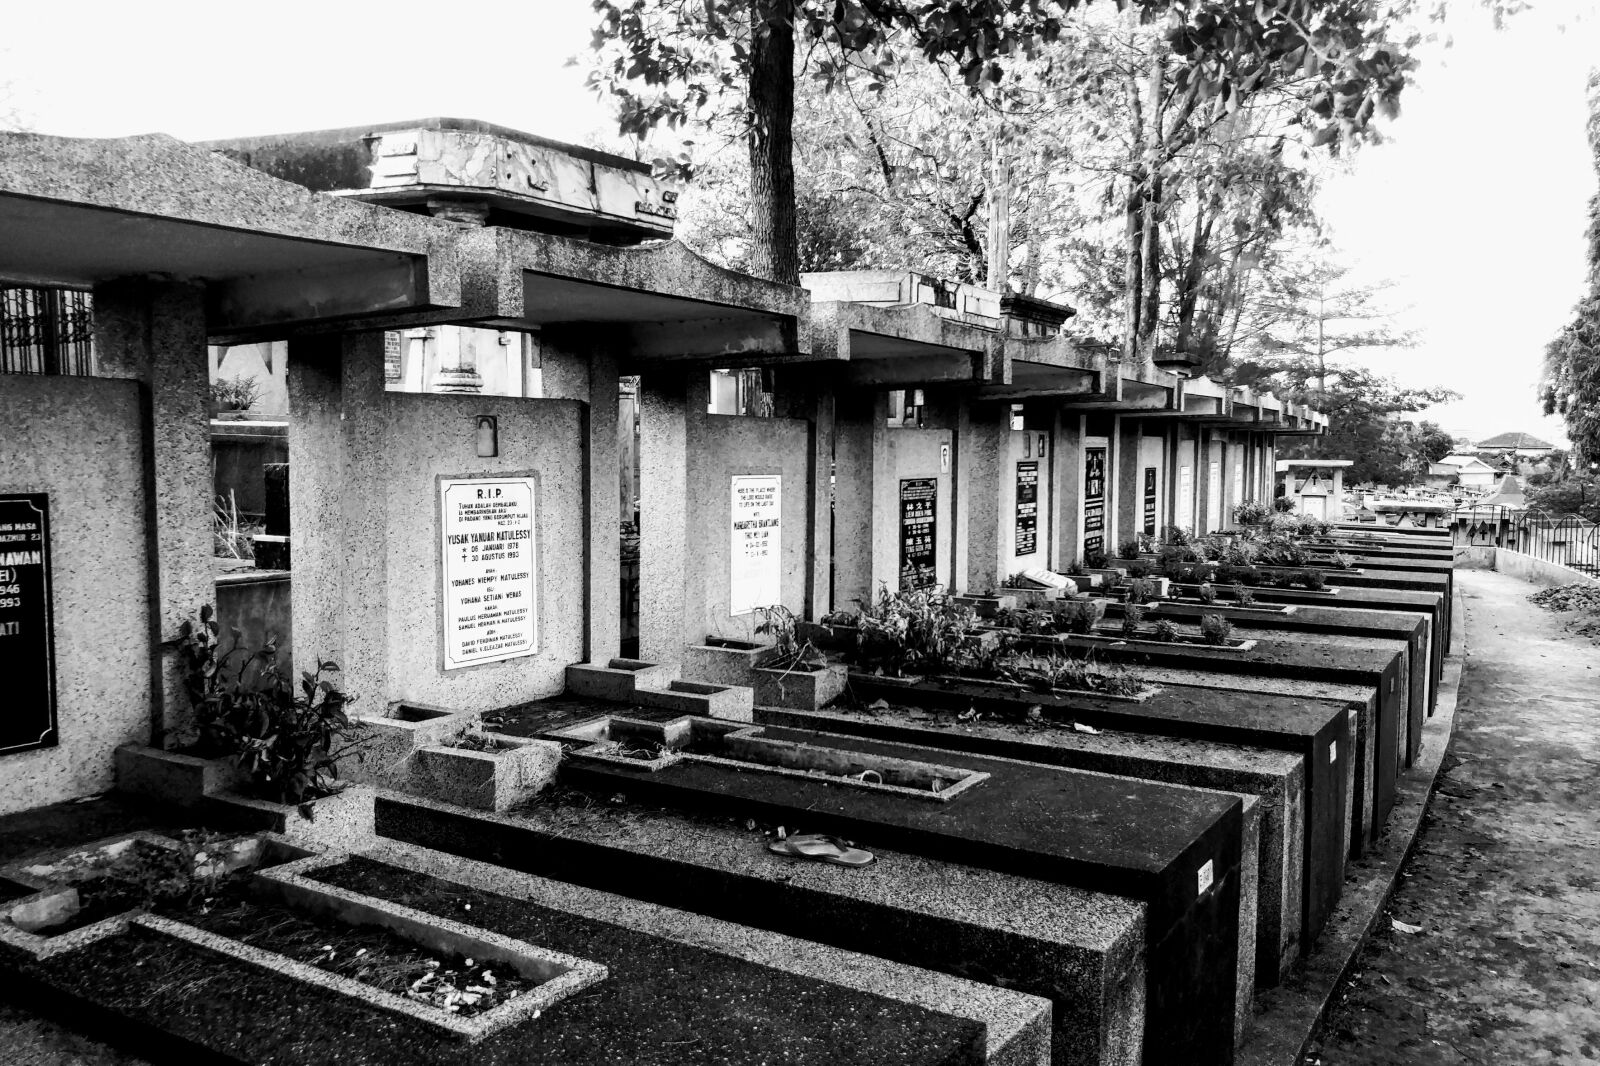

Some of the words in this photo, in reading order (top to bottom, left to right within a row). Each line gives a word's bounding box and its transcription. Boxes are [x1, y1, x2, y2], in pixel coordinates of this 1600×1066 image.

[14, 522, 37, 531] MASA
[0, 534, 26, 542] AZMUR
[30, 533, 41, 541] 23
[448, 534, 469, 545] YUSAK
[471, 532, 495, 543] YANUAR
[497, 530, 530, 541] MATULESSY
[482, 543, 505, 551] JANUARI
[482, 553, 505, 561] AGUSTUS
[452, 578, 475, 587] YOHANES
[501, 572, 529, 581] MATULESSY
[459, 615, 476, 623] PAULUS
[504, 608, 528, 616] MATULESSY
[459, 623, 476, 631] SAMUEL
